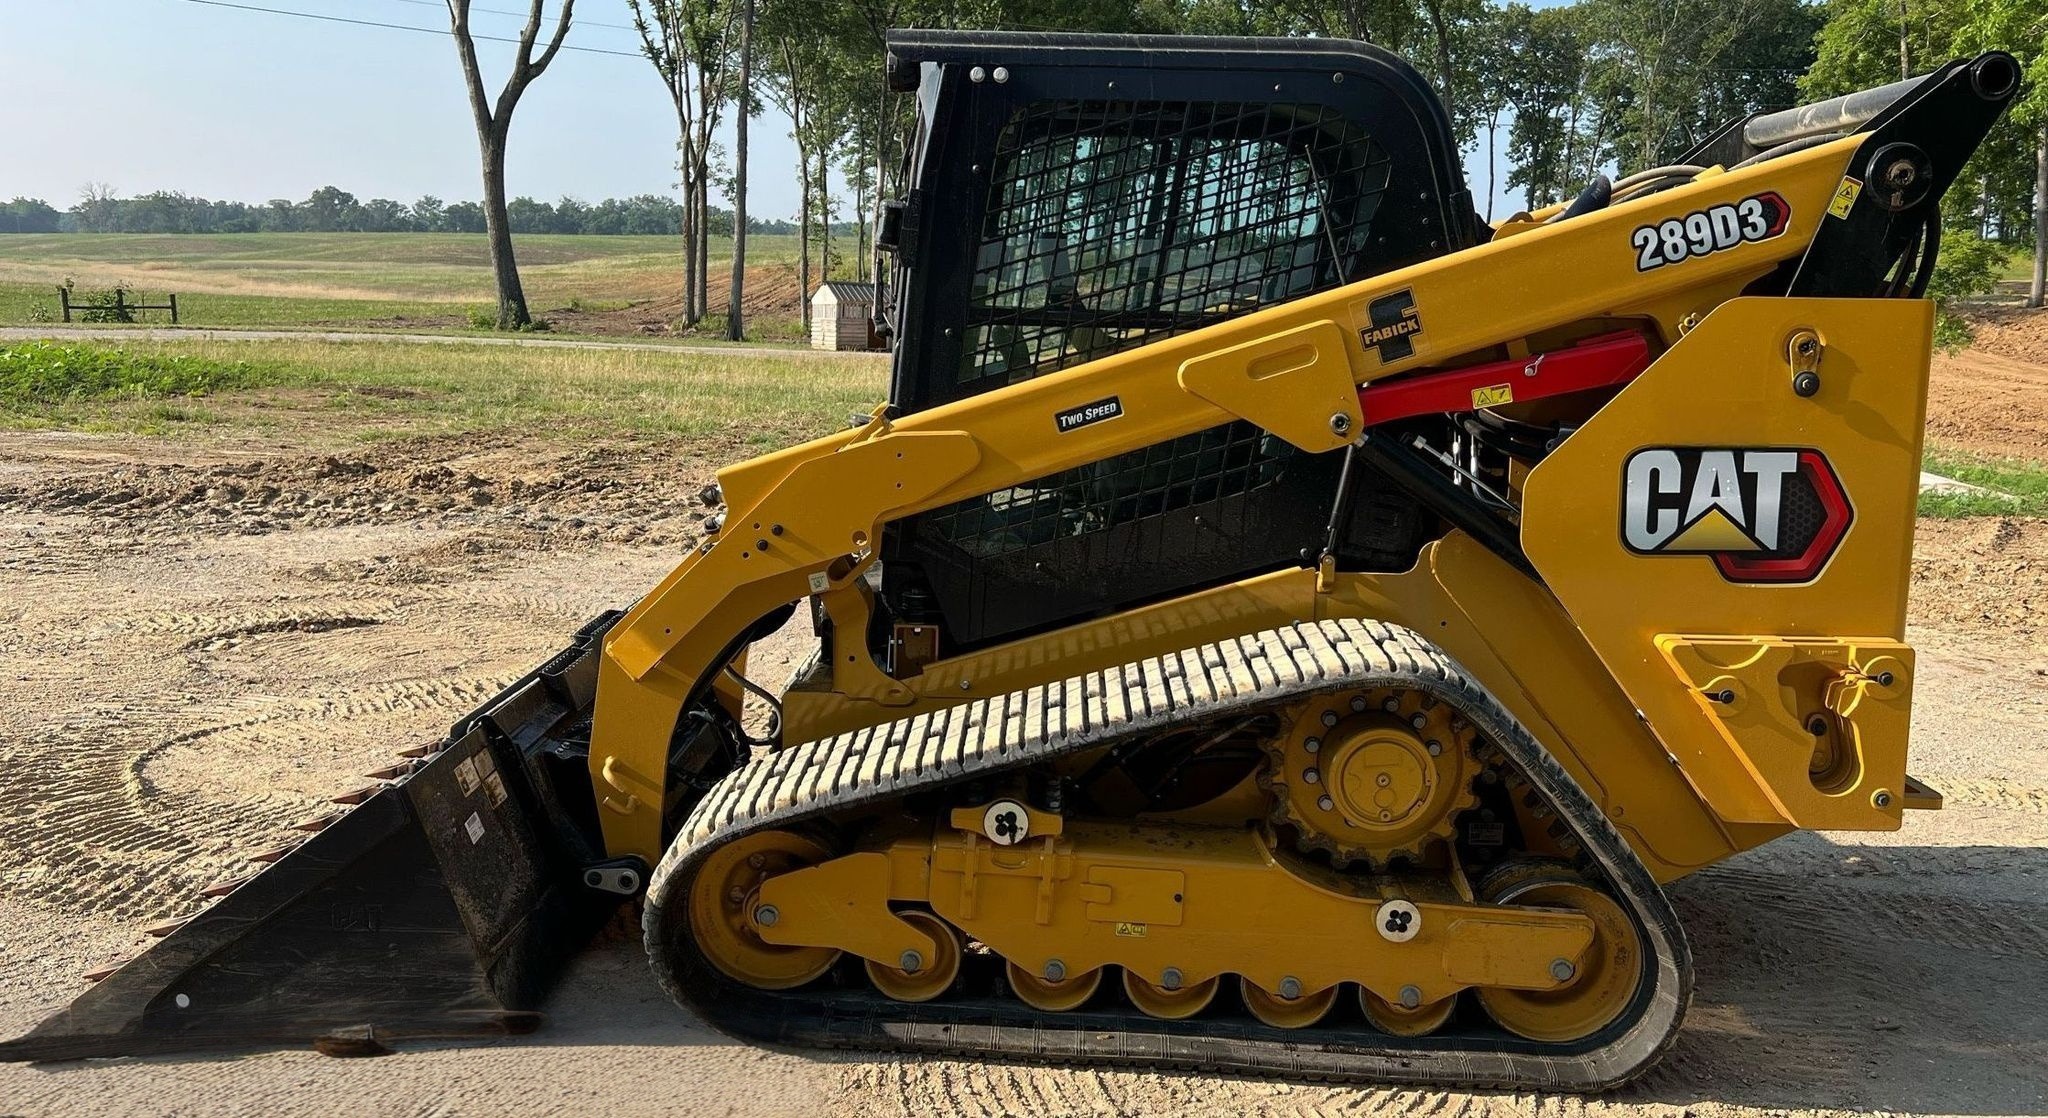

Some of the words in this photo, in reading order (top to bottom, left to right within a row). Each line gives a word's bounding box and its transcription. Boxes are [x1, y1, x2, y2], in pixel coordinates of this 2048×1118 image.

[1634, 199, 1767, 269] 289D3
[1363, 318, 1419, 345] FABICK
[1060, 412, 1083, 427] TWO
[1085, 402, 1117, 420] SPEED
[1625, 450, 1798, 551] CAT
